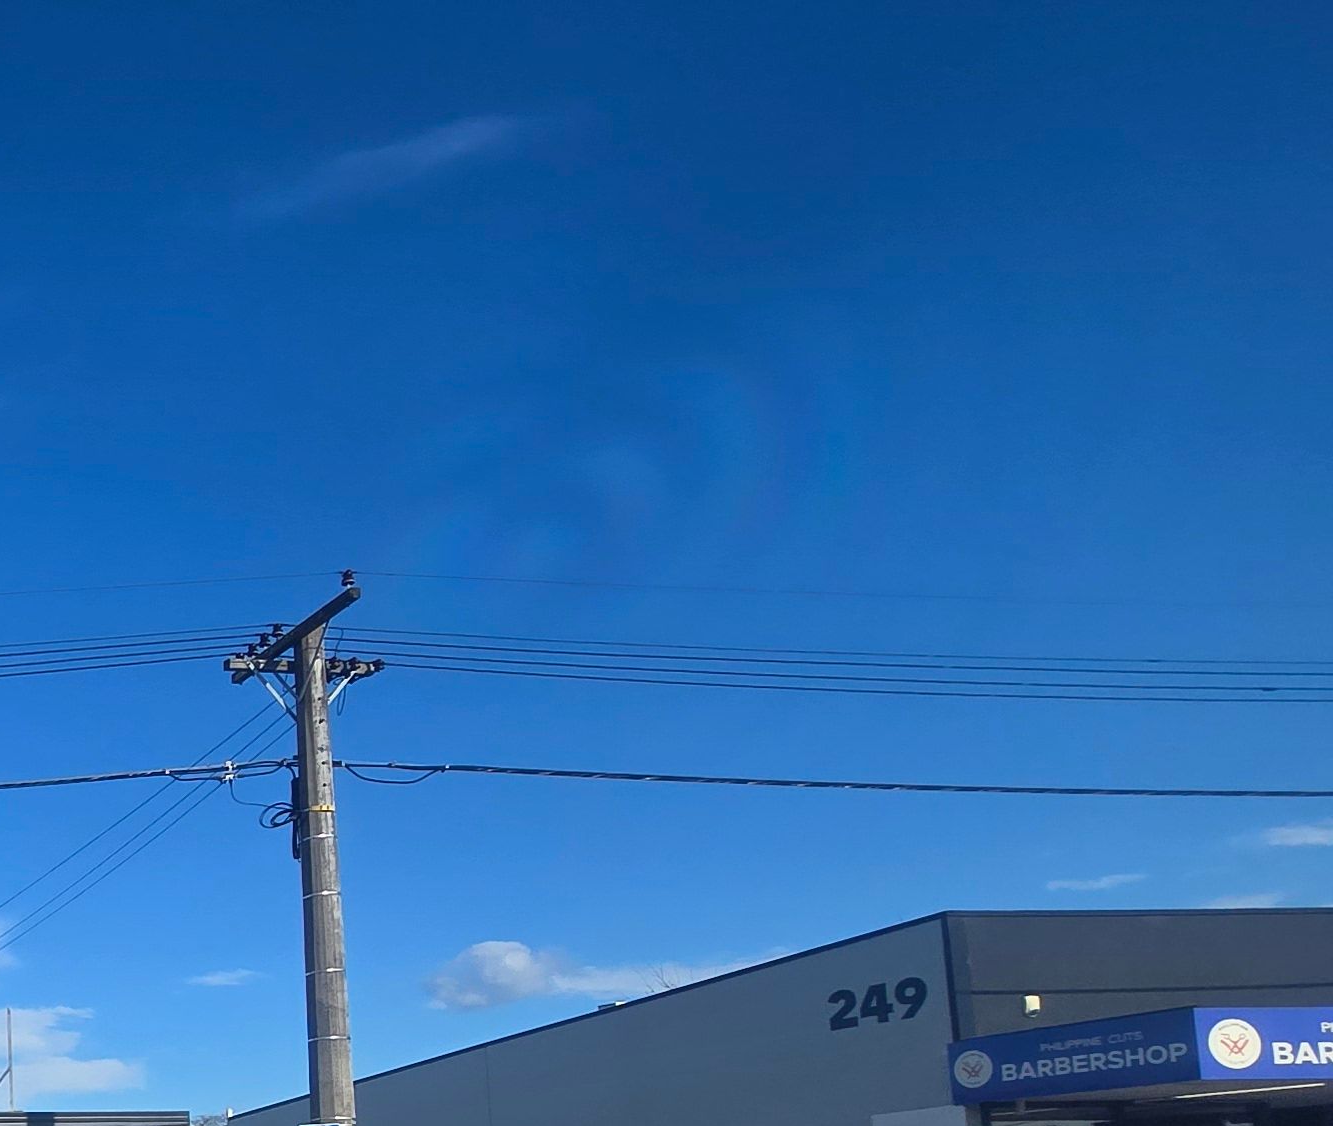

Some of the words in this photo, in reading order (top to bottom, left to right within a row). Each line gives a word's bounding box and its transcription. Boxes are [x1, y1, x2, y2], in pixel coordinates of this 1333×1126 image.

[828, 977, 927, 1031] 249
[1040, 1036, 1102, 1052] PHILIPPINE
[1107, 1031, 1144, 1044] CUTS
[1001, 1043, 1188, 1082] BARBERSHOP
